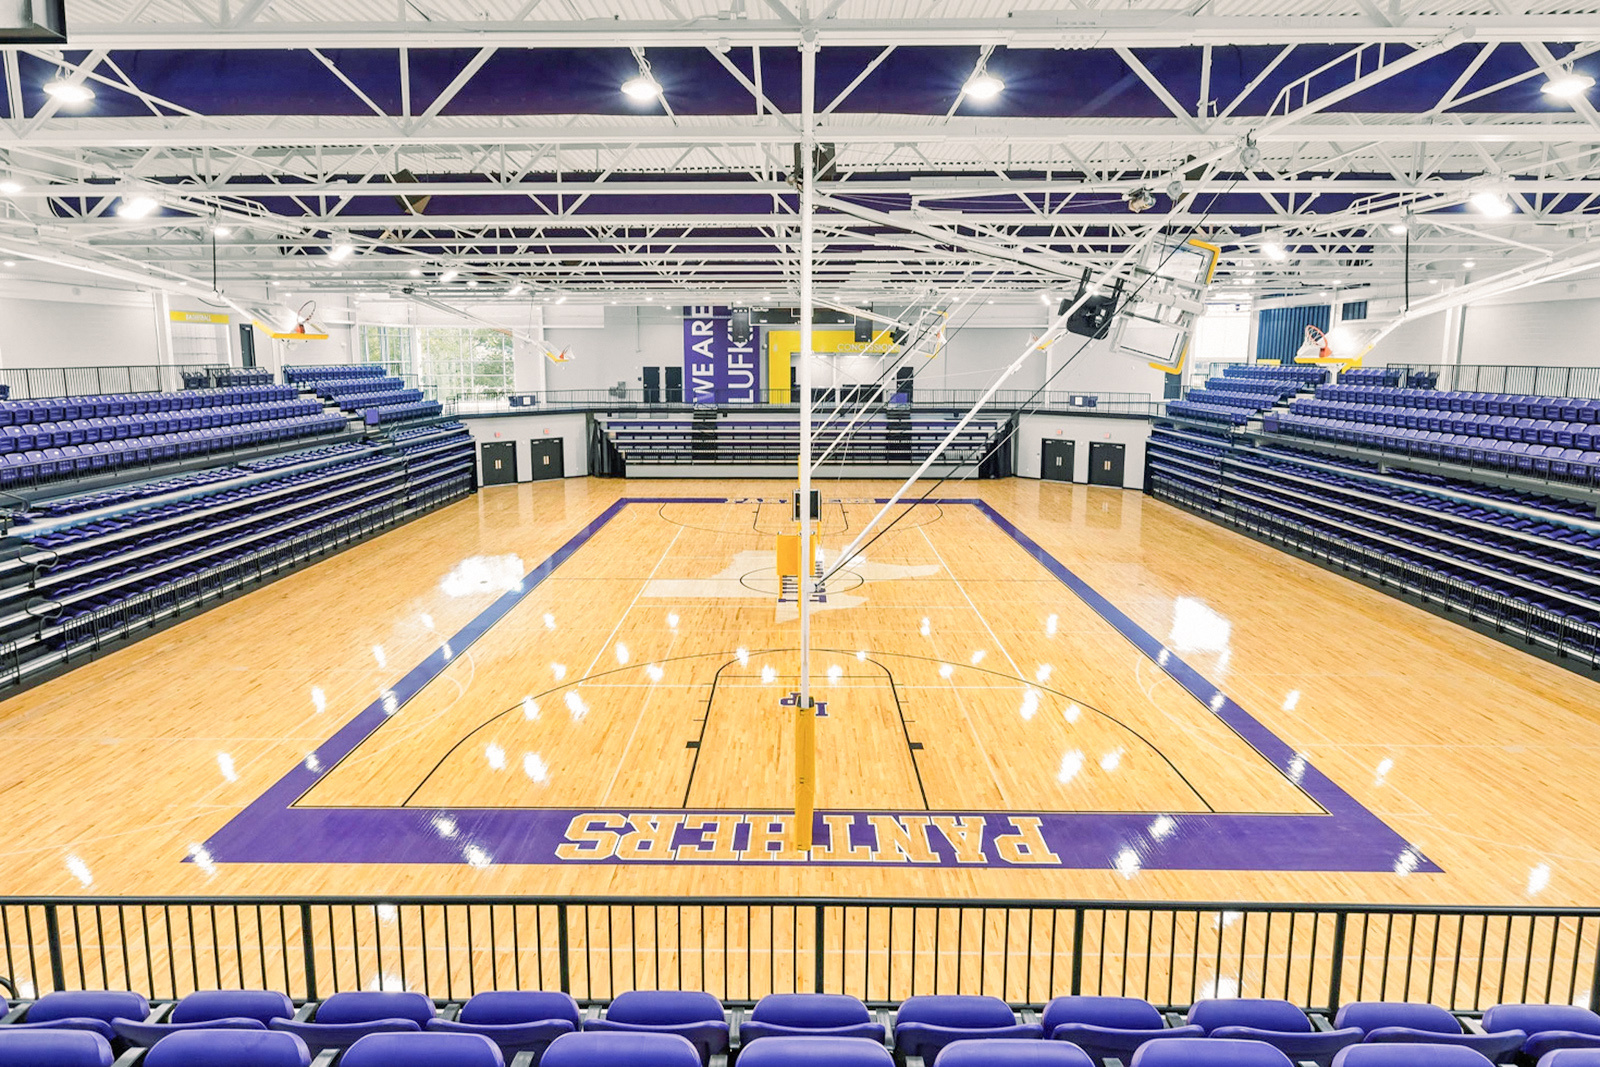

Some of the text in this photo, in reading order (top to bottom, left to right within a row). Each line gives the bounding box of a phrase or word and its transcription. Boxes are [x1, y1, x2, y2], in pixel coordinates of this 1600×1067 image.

[691, 306, 715, 403] WE ARE
[554, 813, 1062, 864] PANTHERS
